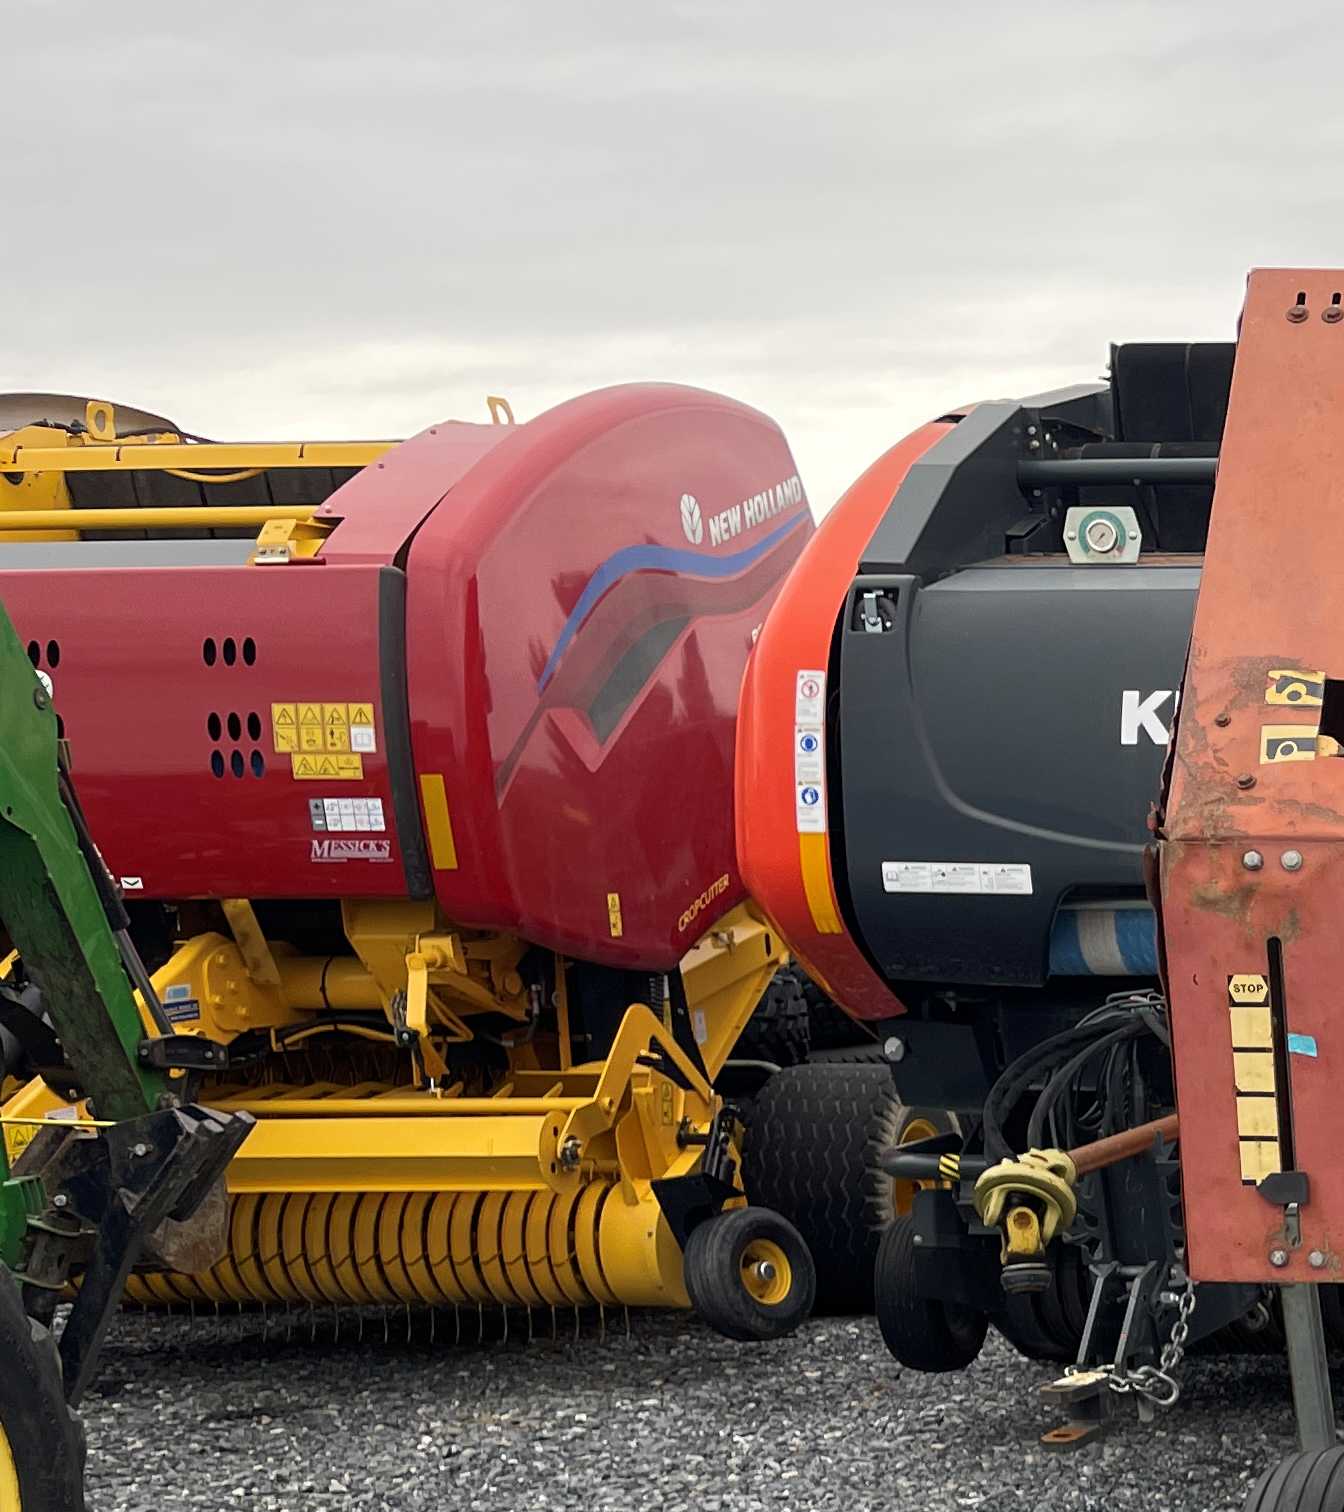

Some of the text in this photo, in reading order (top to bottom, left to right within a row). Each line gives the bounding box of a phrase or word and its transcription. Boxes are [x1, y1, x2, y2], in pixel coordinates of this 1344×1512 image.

[708, 475, 801, 547] NEW HOLLAND
[310, 840, 390, 858] MESSICK'S
[678, 873, 729, 932] CROPCUTTER
[1233, 983, 1264, 993] STOP
